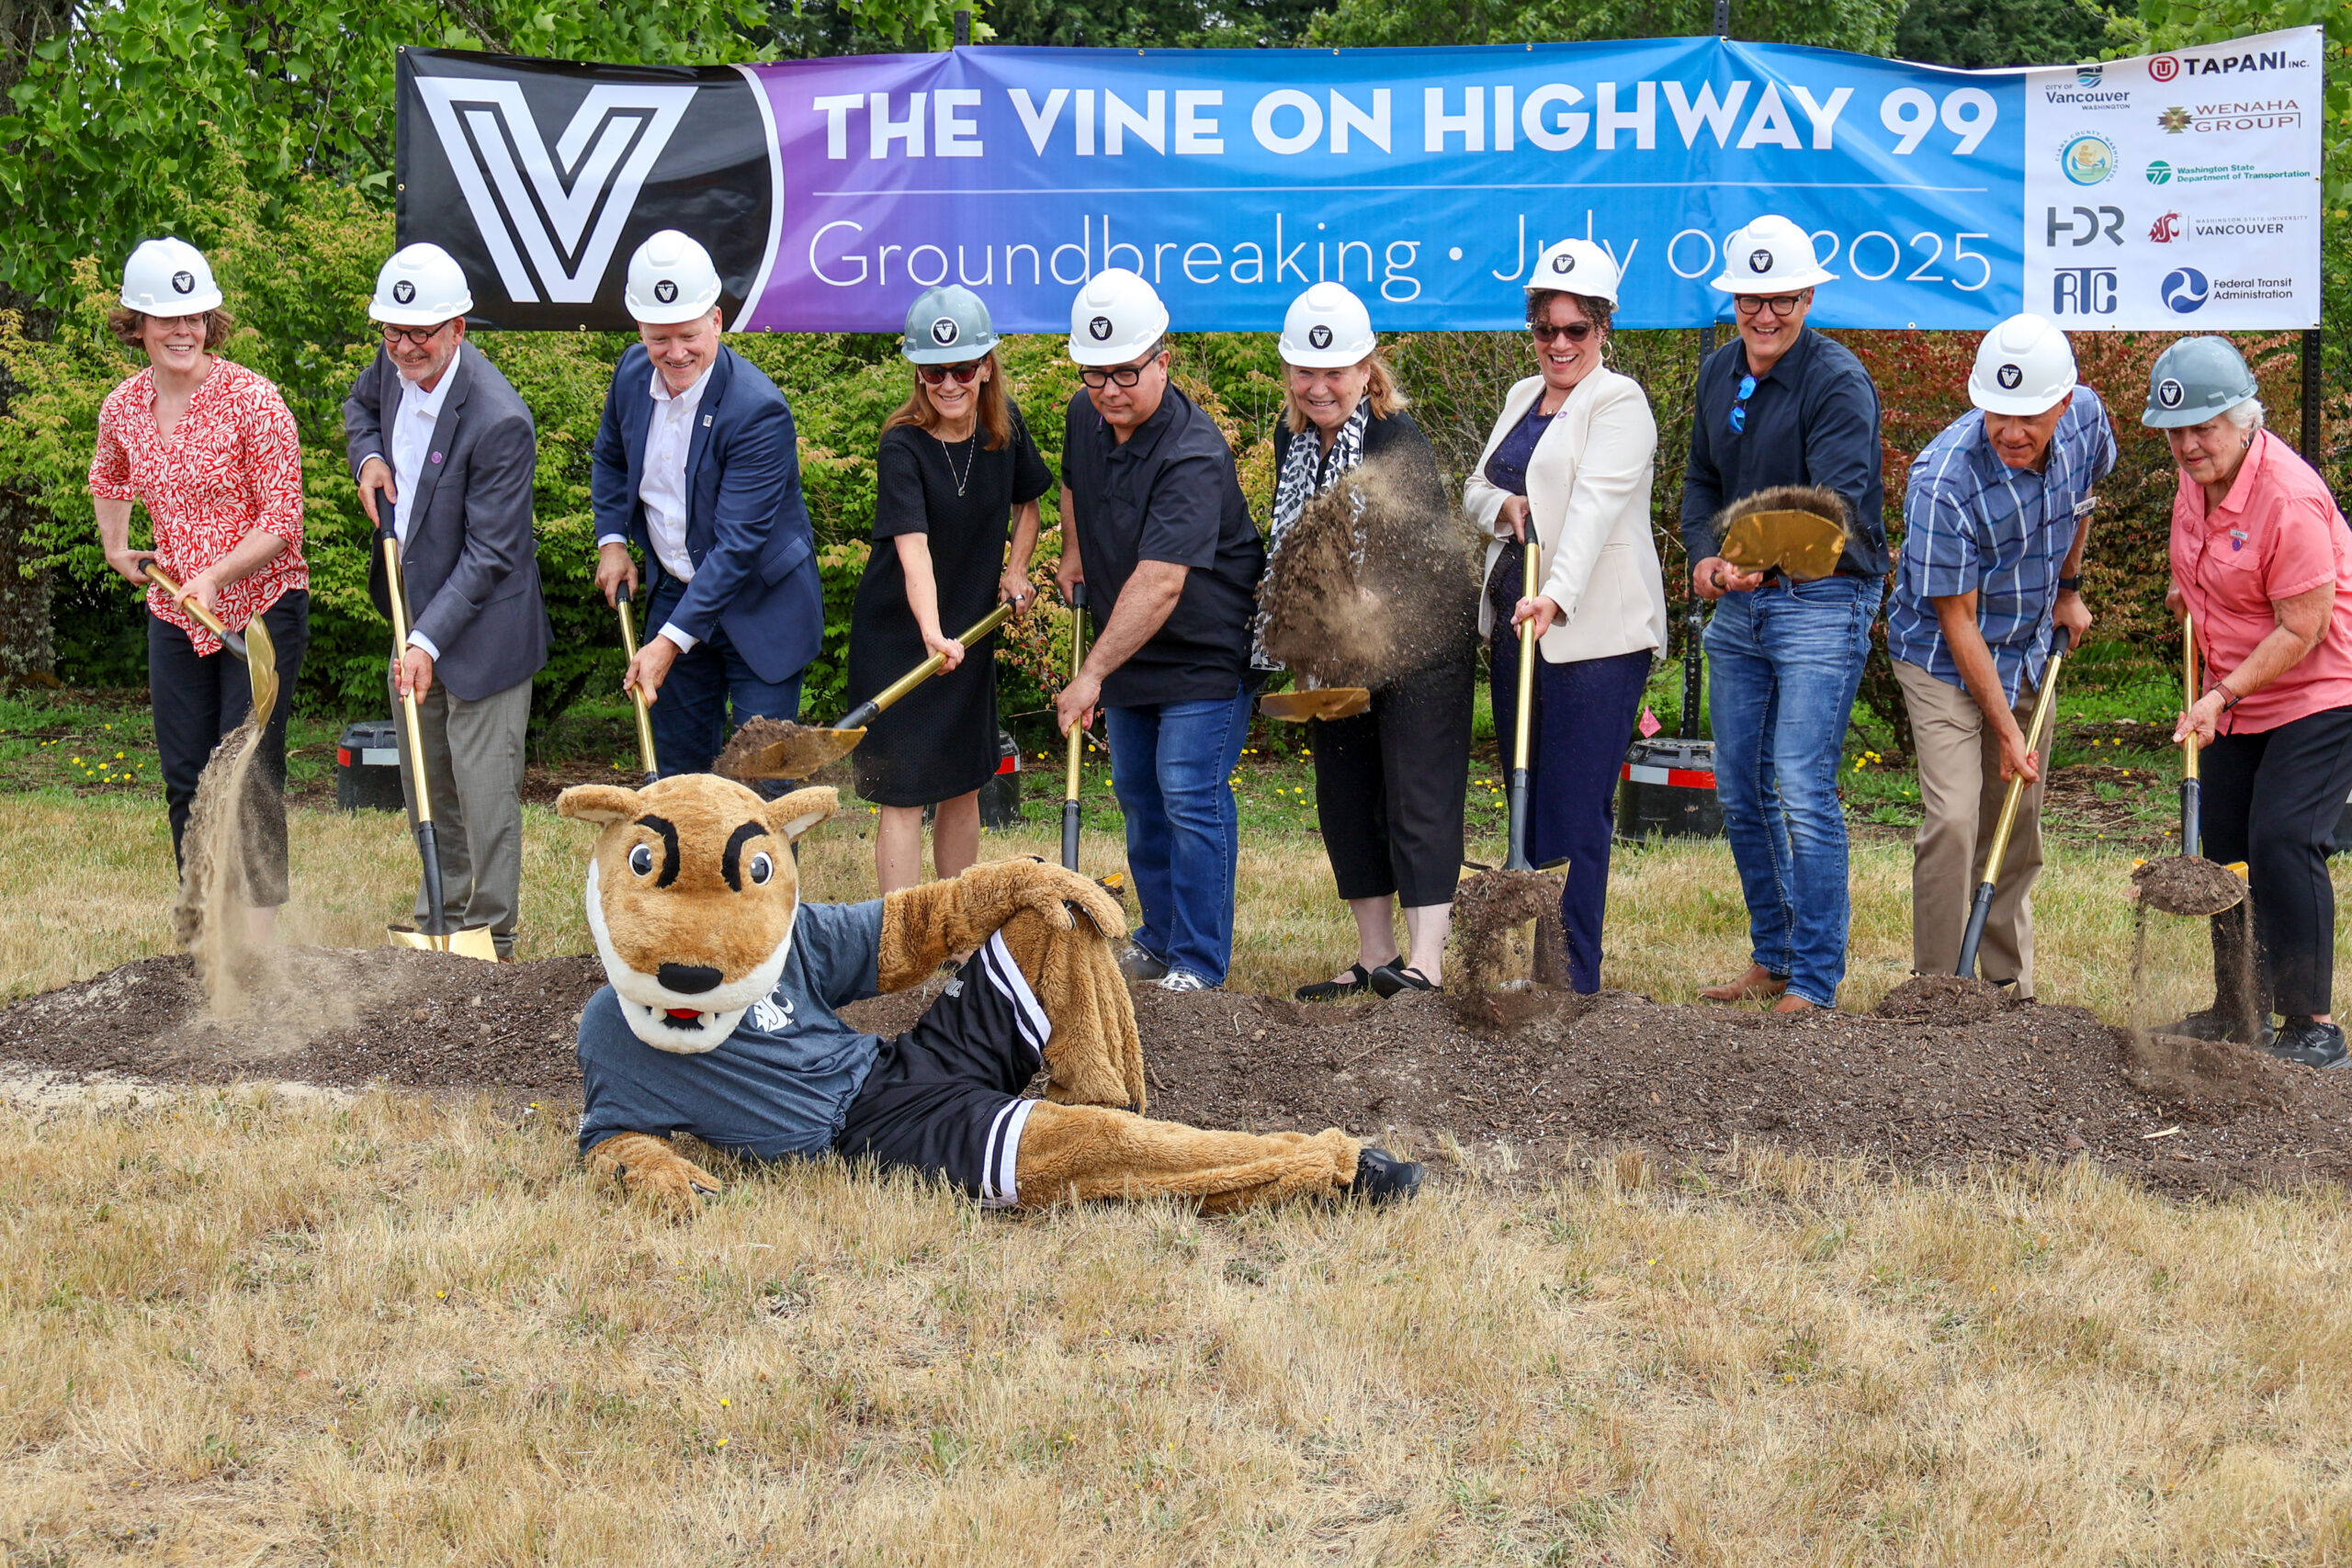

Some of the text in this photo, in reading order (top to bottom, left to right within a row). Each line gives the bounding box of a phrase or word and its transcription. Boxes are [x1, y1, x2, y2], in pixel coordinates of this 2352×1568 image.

[2184, 51, 2286, 75] TAPANI
[2045, 92, 2130, 103] Vancouver
[2196, 99, 2299, 116] WENAHA
[813, 79, 1997, 160] THE VINE ON HIGHWAY 99
[2194, 117, 2293, 133] GROUP
[2177, 166, 2229, 175] Washington
[2177, 174, 2230, 183] Department
[2244, 170, 2311, 180] Transportation
[2047, 206, 2124, 247] HDR
[2196, 223, 2284, 235] VANCOUVER
[808, 211, 1421, 303] Groundbreaking
[2053, 266, 2117, 314] RTC
[2214, 277, 2292, 288] Federal Transit
[2213, 289, 2293, 299] Administration
